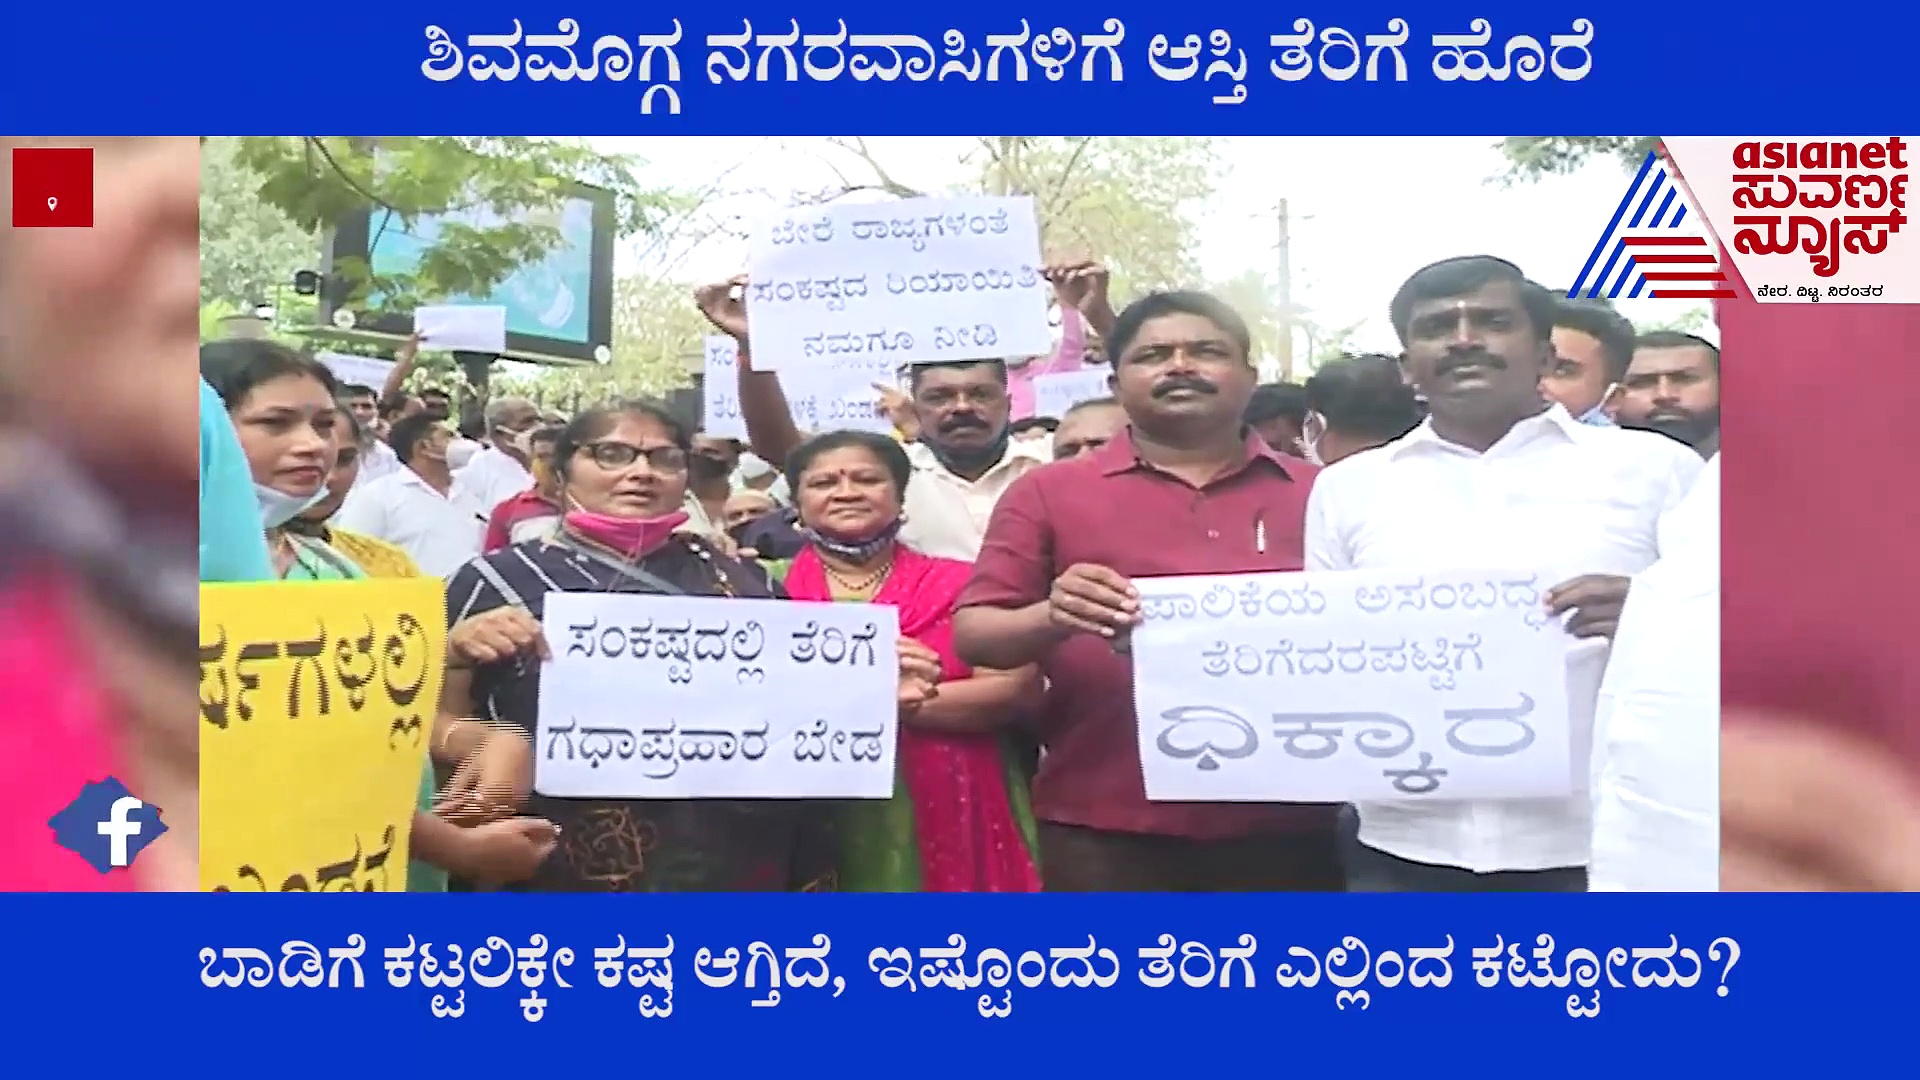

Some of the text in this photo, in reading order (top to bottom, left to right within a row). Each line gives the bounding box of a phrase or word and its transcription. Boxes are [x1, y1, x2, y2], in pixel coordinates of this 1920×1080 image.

[567, 615, 878, 684] ಸಂಕಷ್ಟದಲ್ಲಿ ತೆರಿಗೆ
[546, 715, 884, 780] ಗಧಾಪ್ರಹಾರ ಬೇಡ
